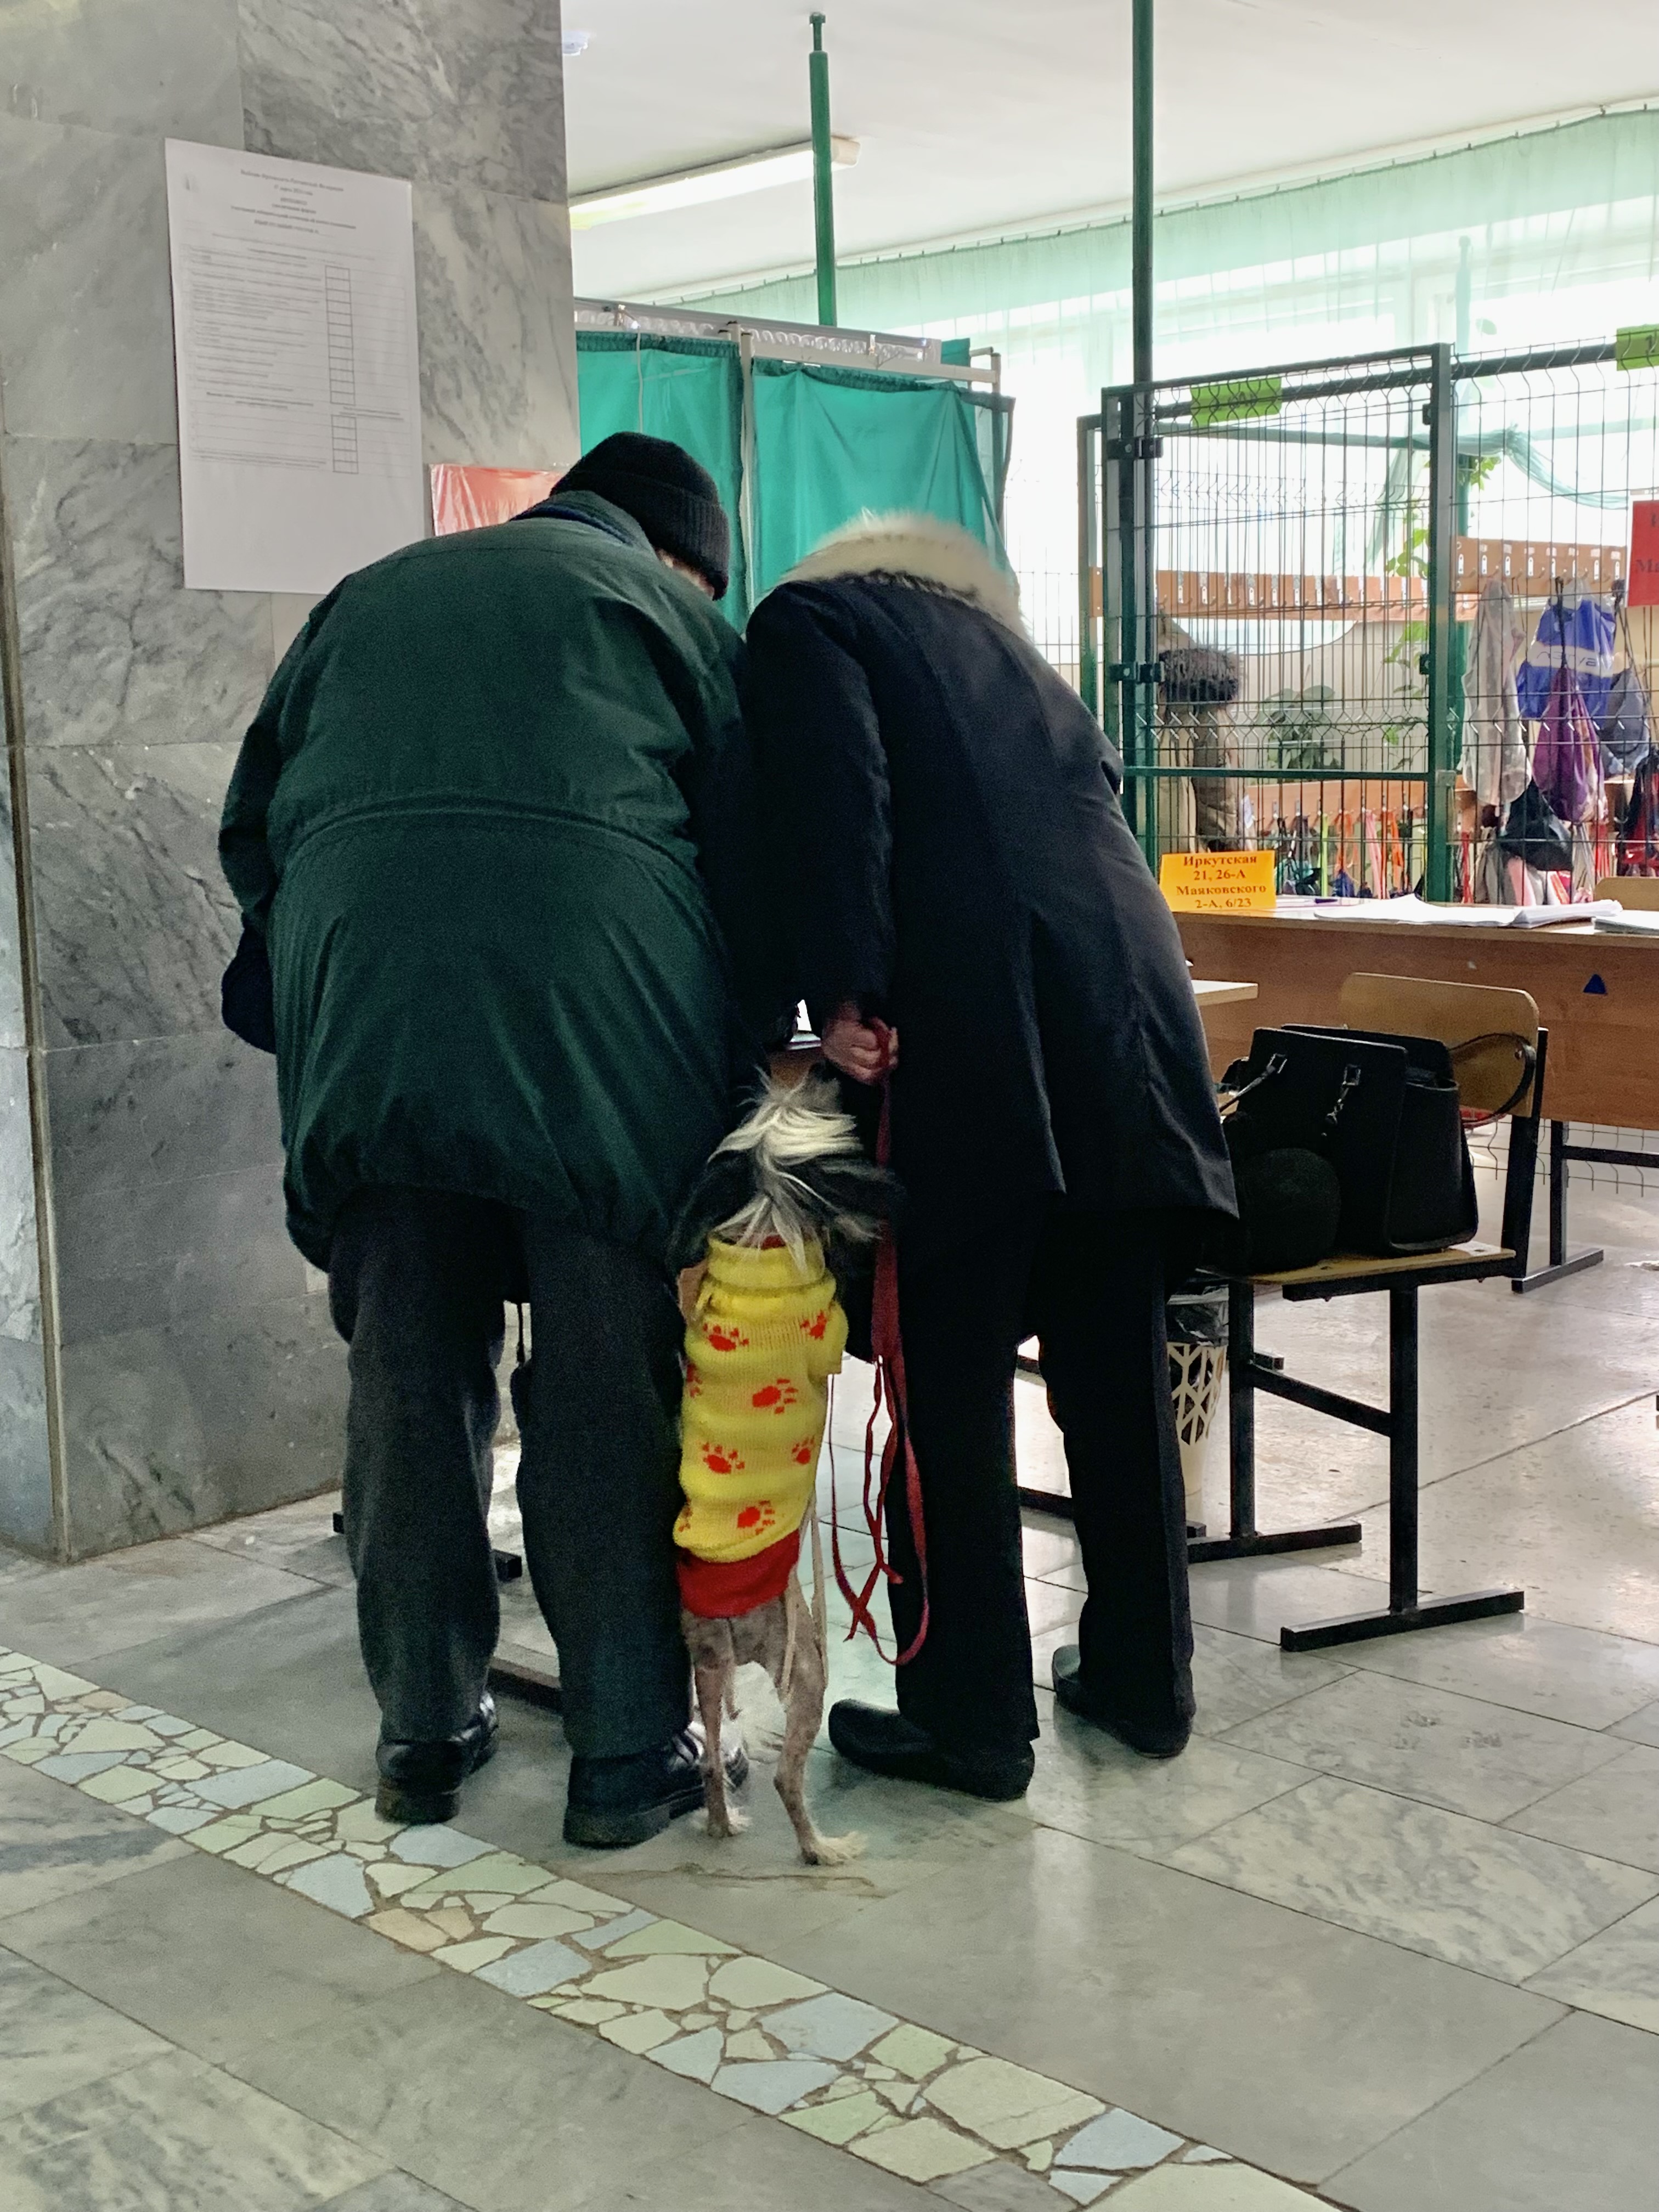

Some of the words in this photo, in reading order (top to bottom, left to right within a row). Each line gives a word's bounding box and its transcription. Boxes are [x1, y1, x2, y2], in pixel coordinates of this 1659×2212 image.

[1183, 856, 1257, 868] Иркутская
[1194, 870, 1212, 882] 21,
[1217, 869, 1246, 879] 26-А
[1176, 885, 1267, 896] Маяковского
[1195, 899, 1222, 909] 2-А,
[1226, 898, 1251, 907] 6/23
